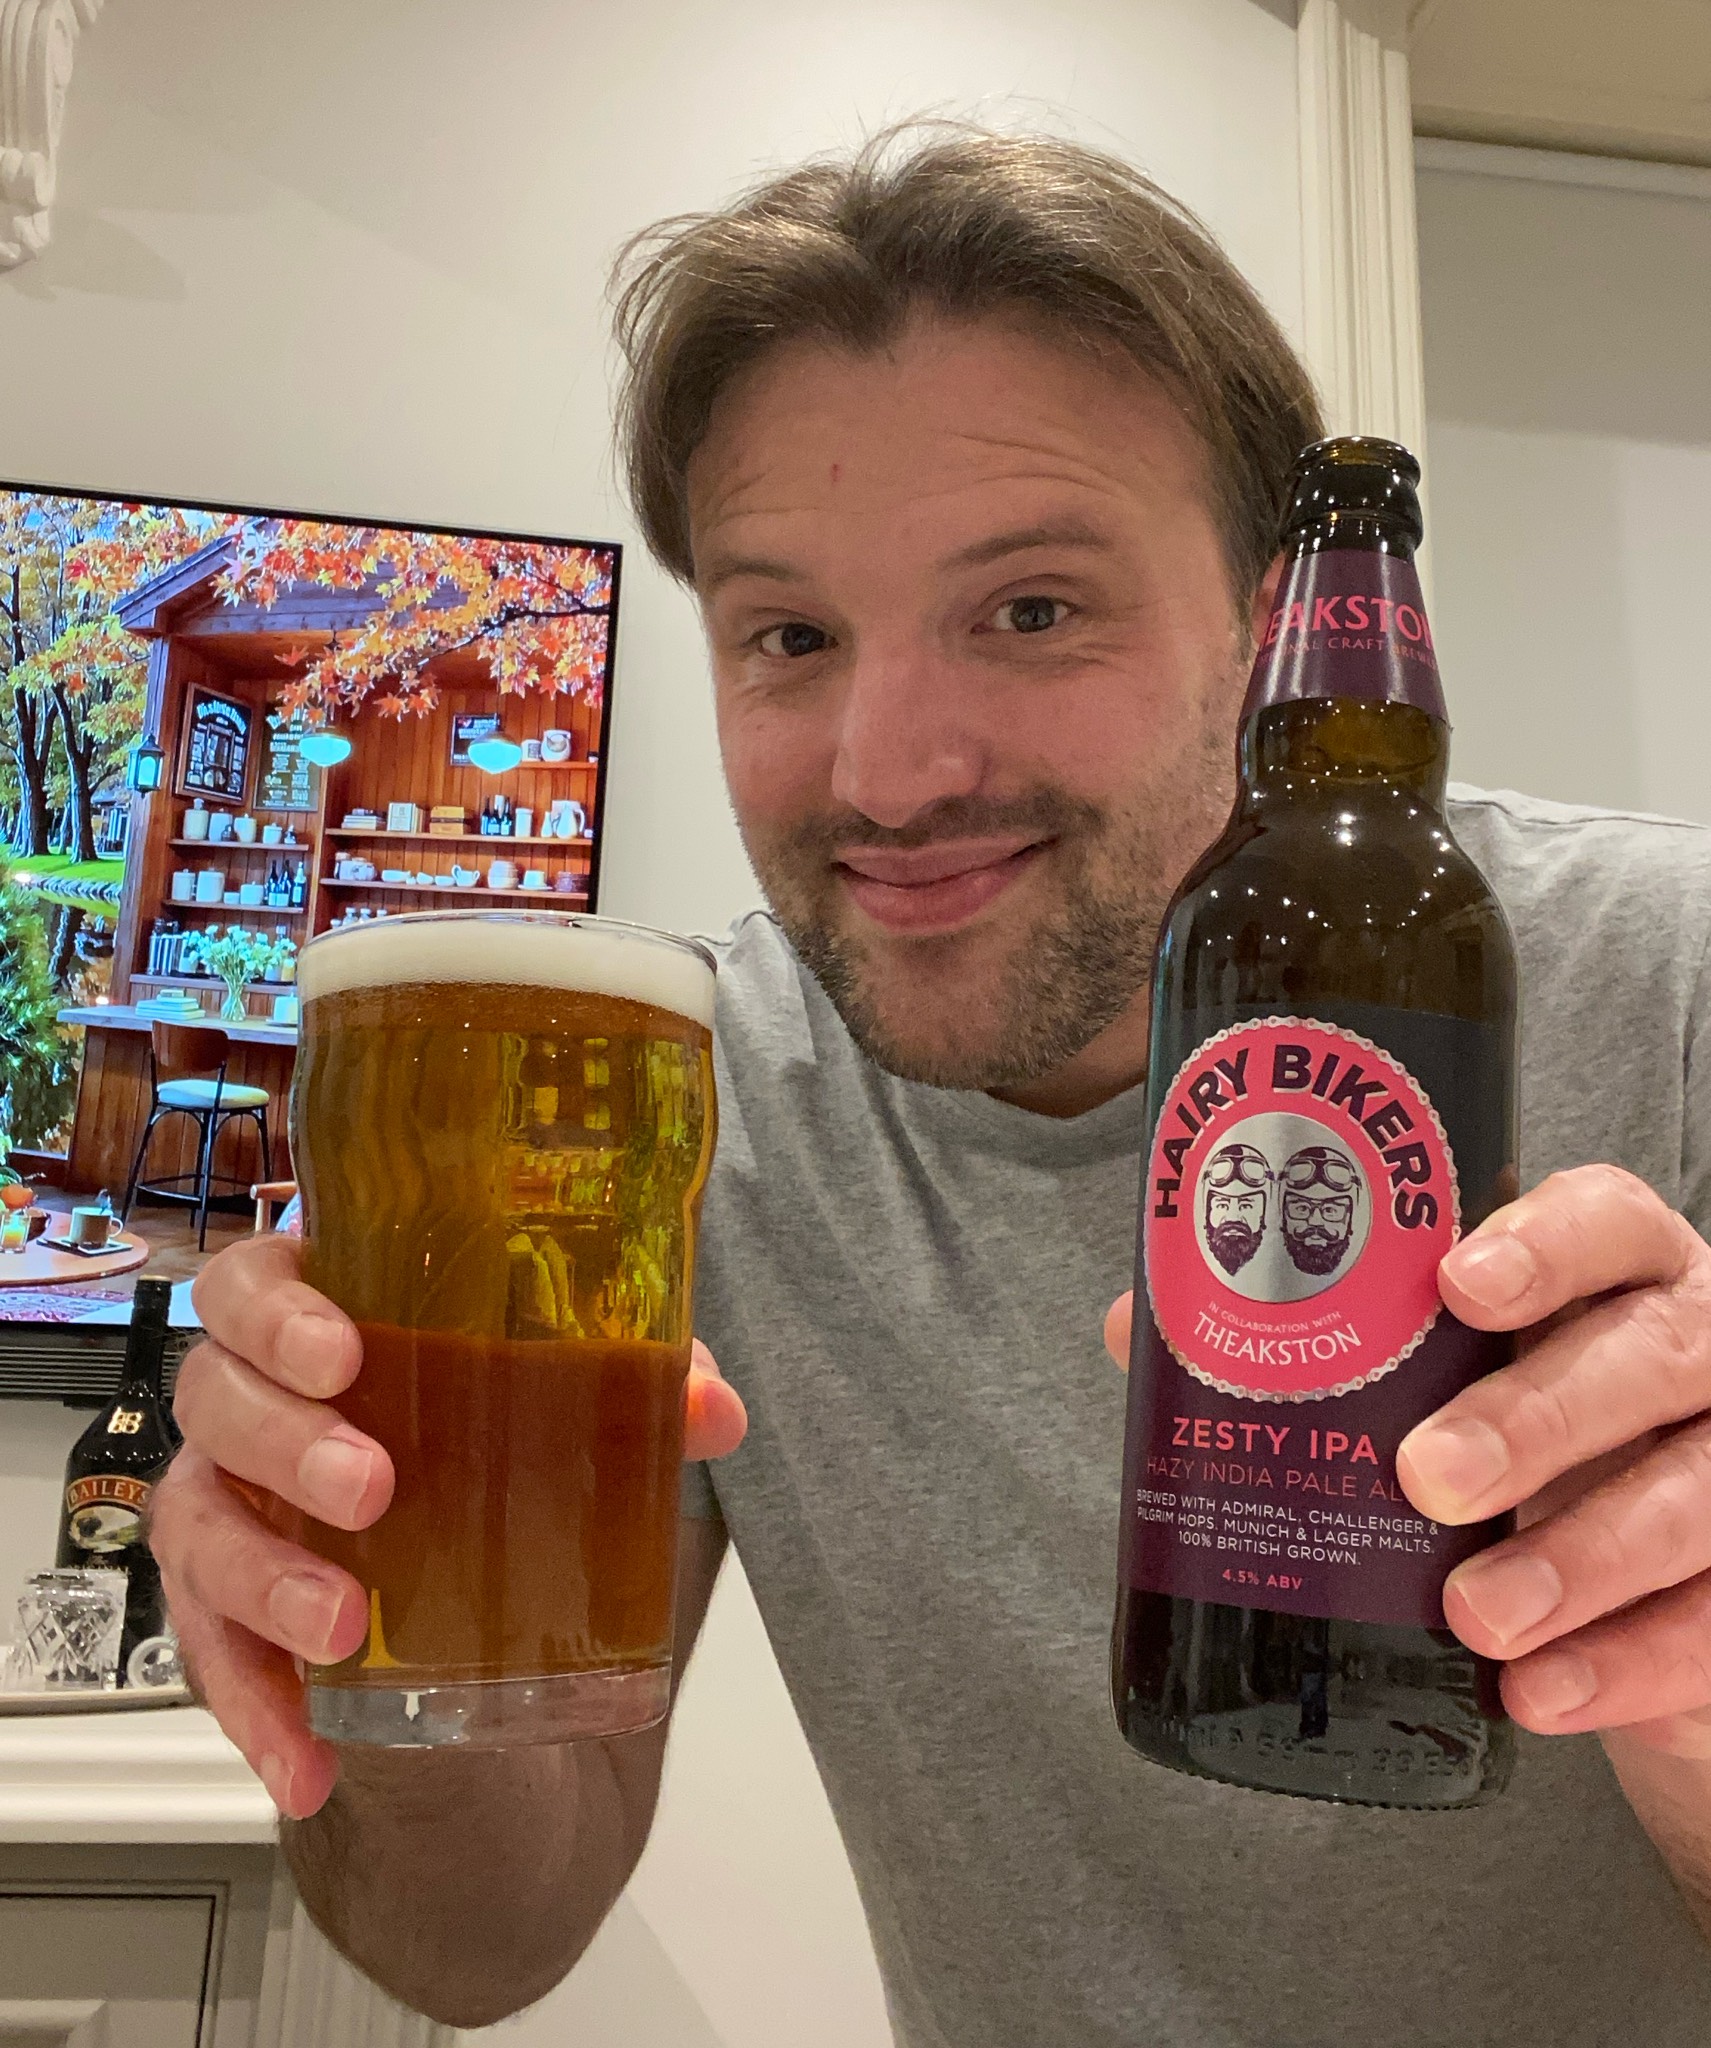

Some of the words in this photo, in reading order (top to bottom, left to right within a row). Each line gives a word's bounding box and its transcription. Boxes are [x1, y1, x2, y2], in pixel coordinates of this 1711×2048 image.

[1327, 636, 1385, 651] CRAFT
[1154, 1047, 1250, 1218] HAIRY
[1271, 1044, 1438, 1231] BIKERS
[1193, 1310, 1363, 1366] THEAKSTON
[1208, 1300, 1220, 1314] IN
[1221, 1310, 1309, 1334] COLLABORATION
[1312, 1310, 1342, 1329] WITH
[1171, 1416, 1291, 1456] ZESTY
[1309, 1428, 1379, 1466] IPA
[1146, 1455, 1196, 1480] HAZY
[1203, 1461, 1274, 1489] INDIA
[1285, 1469, 1357, 1498] PALE
[1368, 1478, 1405, 1502] AL
[1136, 1488, 1177, 1507] BREWED
[1180, 1495, 1216, 1511] WITH
[1308, 1509, 1425, 1535] CHALLENGER
[1428, 1522, 1439, 1536] &
[1136, 1506, 1175, 1525] PILGRIM
[1223, 1518, 1289, 1539] MUNICH
[1296, 1527, 1307, 1541] &
[1313, 1529, 1373, 1548] LAGER
[1379, 1535, 1435, 1554] MALTS.
[1178, 1530, 1212, 1548] 100%
[1216, 1535, 1281, 1557] BRITISH
[1286, 1544, 1361, 1566] GROWN.
[1221, 1568, 1260, 1586] 4.5%
[1266, 1574, 1303, 1590] ABV
